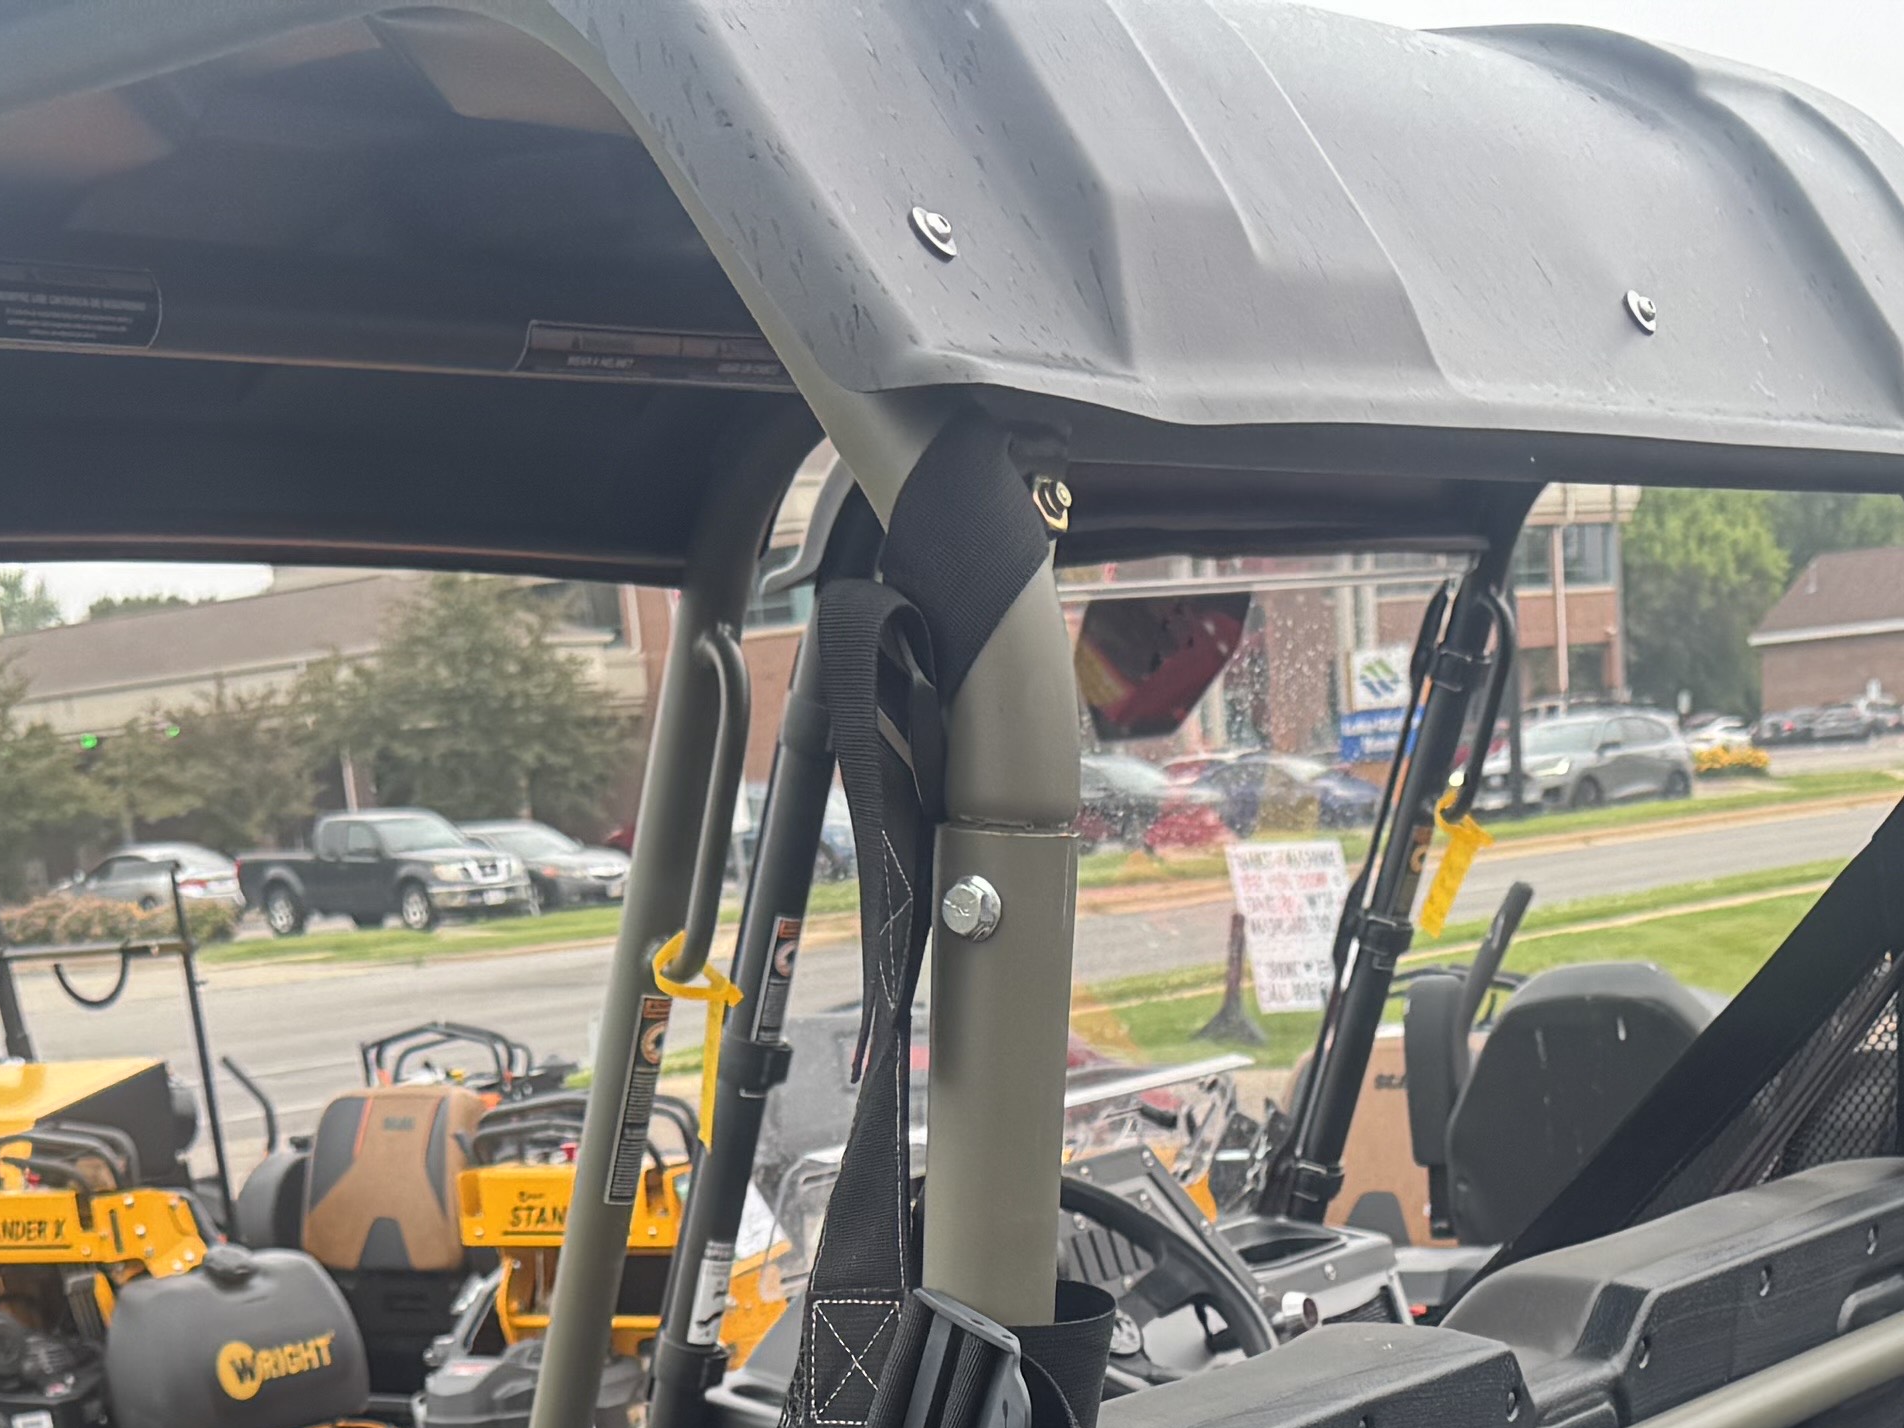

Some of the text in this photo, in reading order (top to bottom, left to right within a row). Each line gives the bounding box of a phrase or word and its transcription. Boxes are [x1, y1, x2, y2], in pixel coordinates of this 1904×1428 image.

[509, 1205, 568, 1228] STAN
[52, 1219, 67, 1241] X
[216, 1329, 335, 1400] WRIGHT
